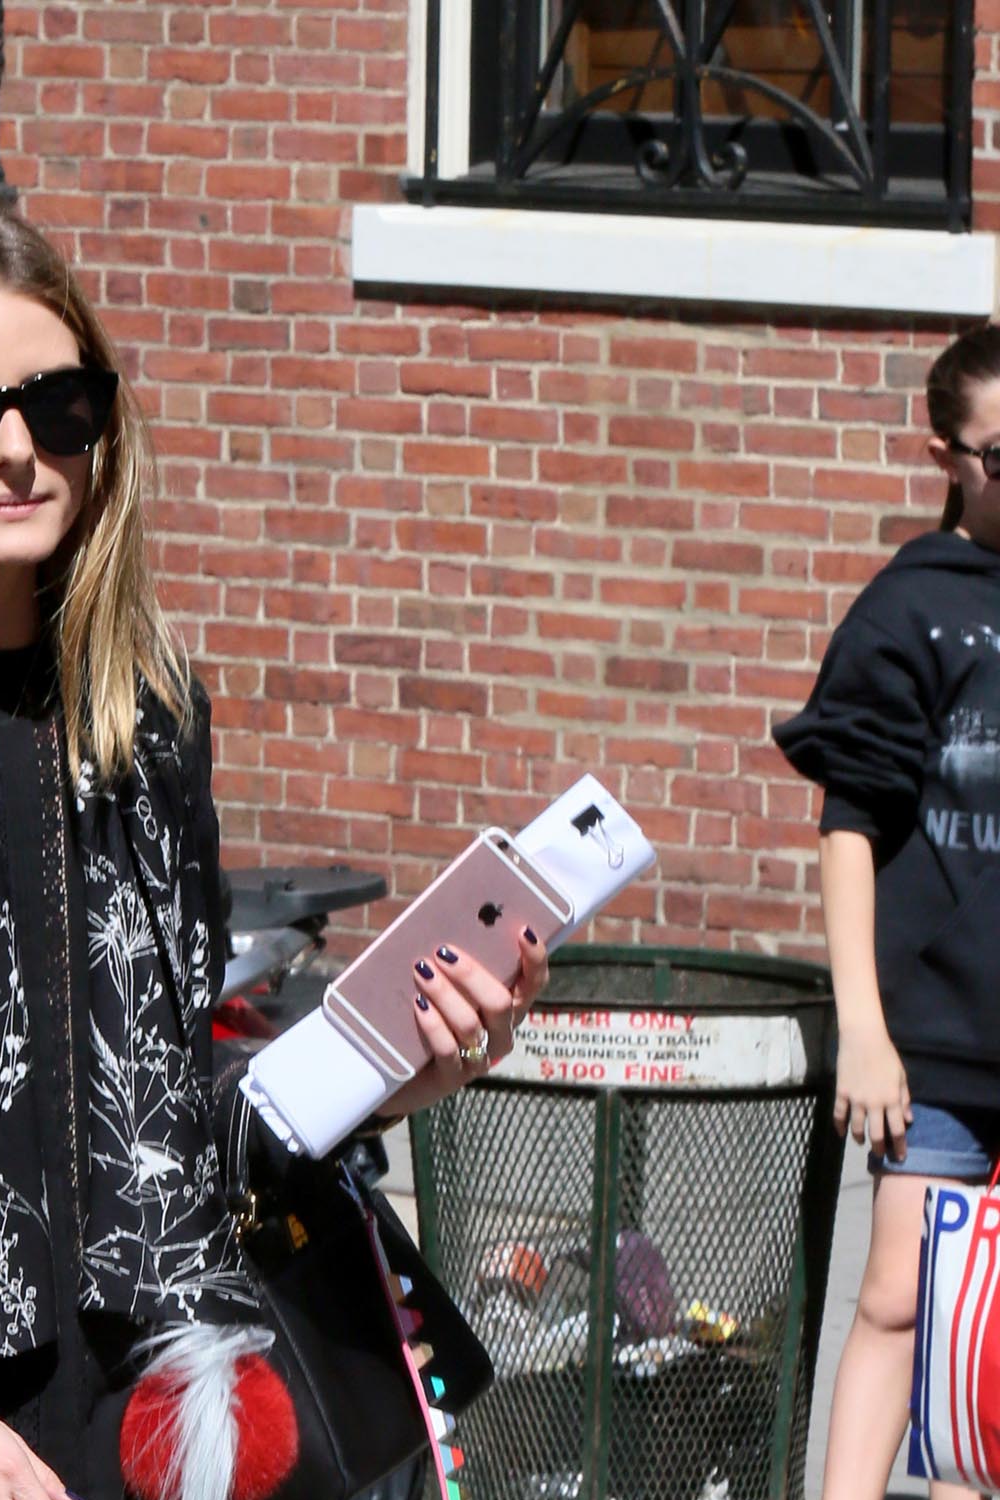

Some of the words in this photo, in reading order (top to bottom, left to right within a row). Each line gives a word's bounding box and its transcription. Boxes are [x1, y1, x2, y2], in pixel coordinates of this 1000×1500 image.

[528, 1010, 611, 1029] LITTER
[629, 1011, 696, 1032] ONLY
[515, 1029, 538, 1040] NO
[544, 1031, 649, 1046] HOUSEHOLD
[657, 1034, 711, 1047] TRASH
[525, 1044, 549, 1057] NO
[554, 1046, 638, 1060] BUSINESS
[647, 1049, 700, 1061] TRASH
[540, 1059, 606, 1081] $100
[624, 1063, 685, 1083] FINE
